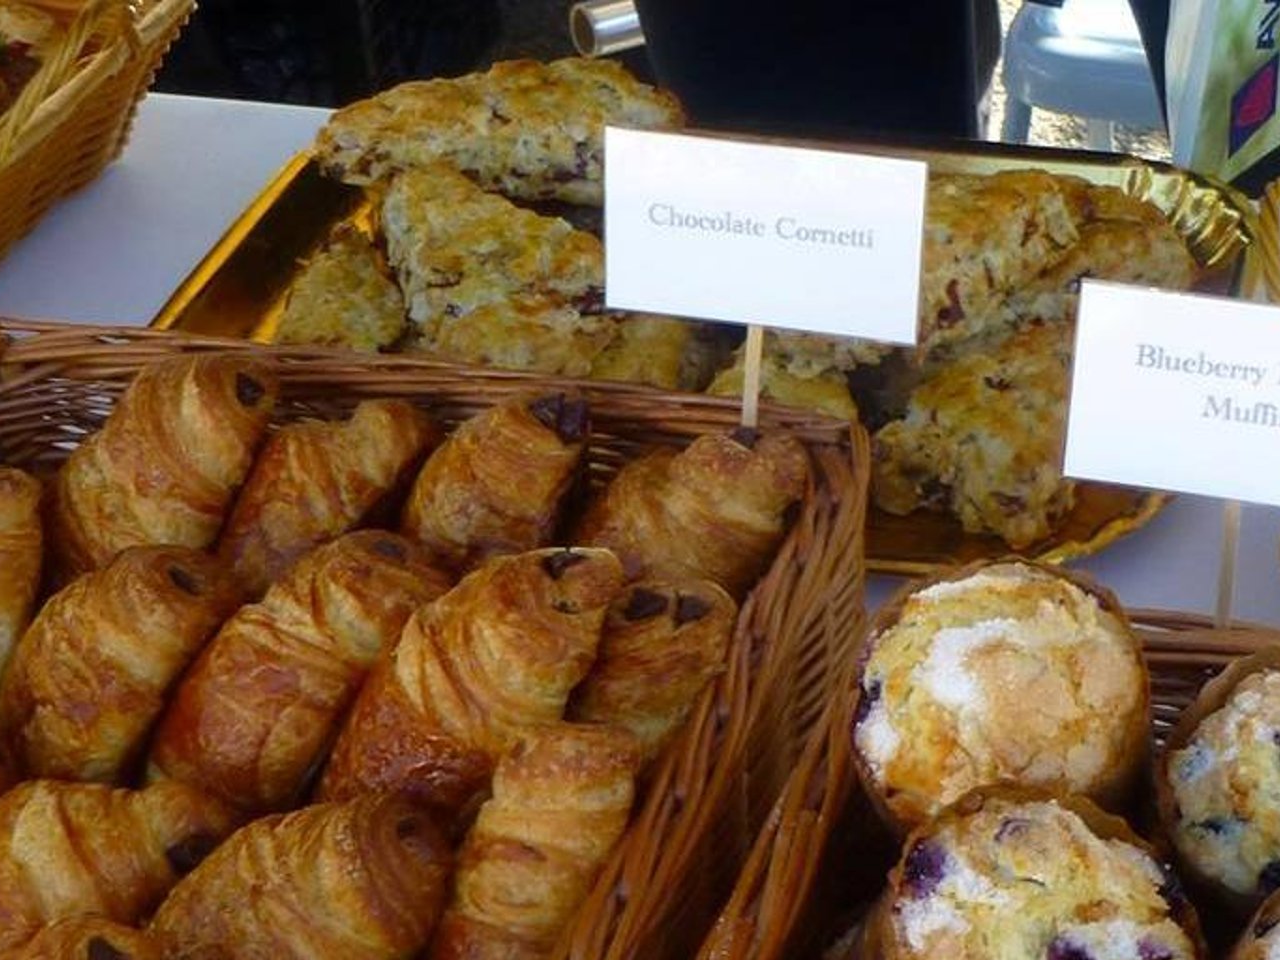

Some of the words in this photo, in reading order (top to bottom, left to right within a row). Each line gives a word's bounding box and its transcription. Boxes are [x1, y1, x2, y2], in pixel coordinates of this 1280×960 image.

[648, 203, 765, 237] Chocolate
[775, 217, 874, 248] Cornetti
[1135, 343, 1267, 386] Blueberry
